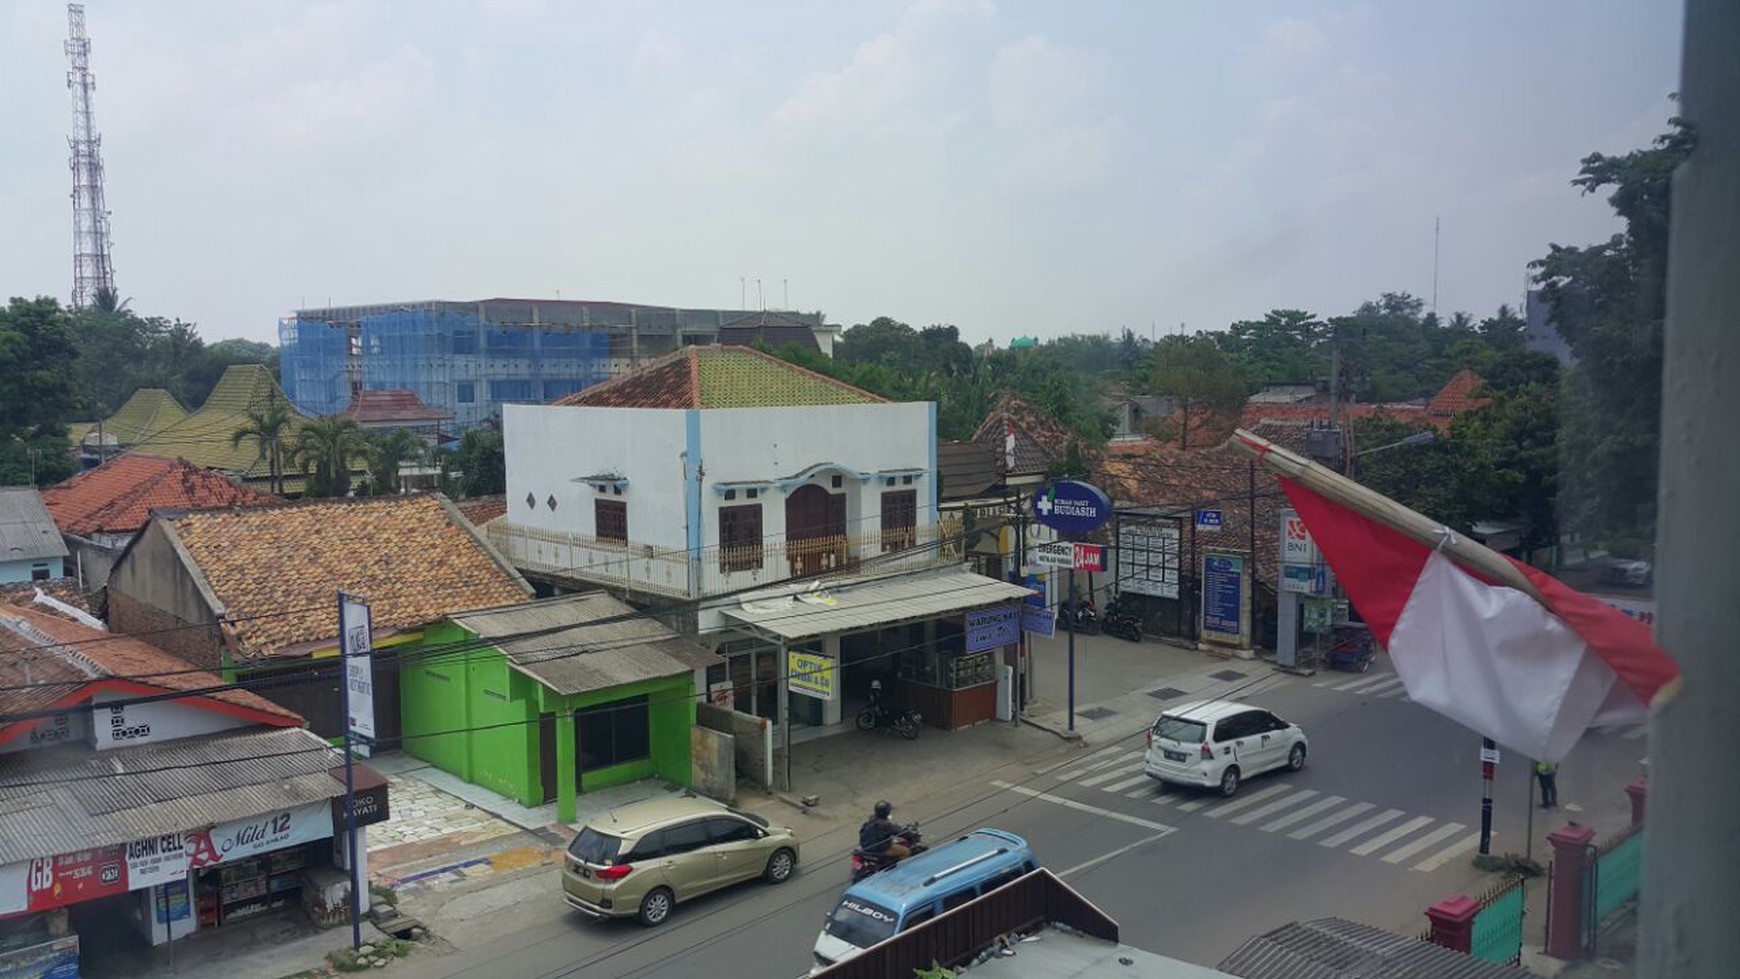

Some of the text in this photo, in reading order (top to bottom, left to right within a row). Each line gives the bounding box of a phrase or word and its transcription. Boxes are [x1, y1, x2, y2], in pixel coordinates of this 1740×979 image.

[1054, 505, 1097, 518] BUDIASIH
[1074, 545, 1085, 569] 24
[1287, 542, 1307, 552] BNI
[221, 820, 269, 853] Mild
[271, 813, 292, 835] 12
[128, 836, 159, 860] AGHNI
[160, 832, 184, 853] CELL
[31, 855, 54, 893] GB
[842, 899, 895, 922] HILBOY
